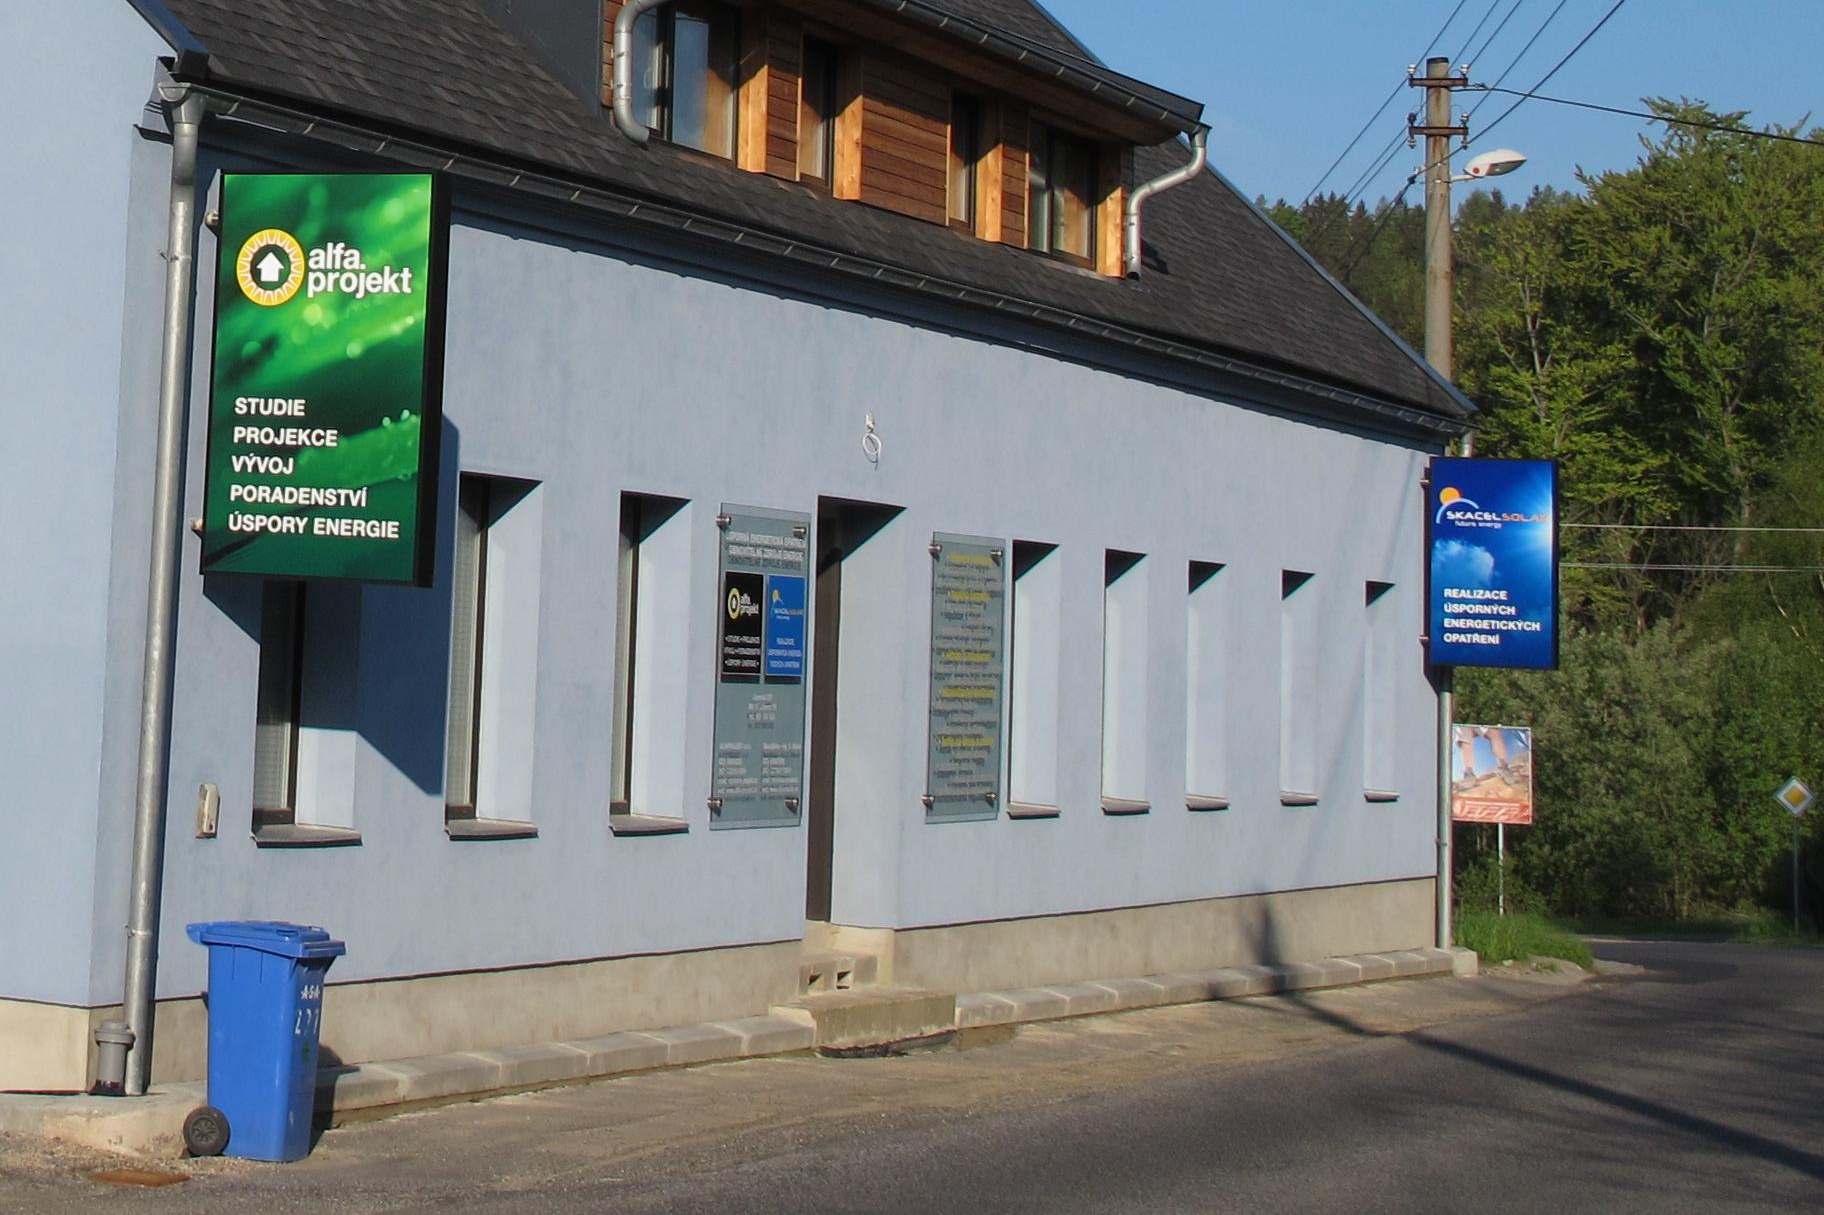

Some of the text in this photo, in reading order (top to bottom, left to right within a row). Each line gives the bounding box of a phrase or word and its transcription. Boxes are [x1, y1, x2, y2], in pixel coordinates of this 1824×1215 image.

[307, 266, 412, 299] projekt
[234, 397, 306, 416] STUDIE
[233, 426, 338, 447] PROJEKCE
[231, 453, 294, 475] VÝVOJ
[230, 484, 368, 507] PORADENSTVÍ
[228, 510, 400, 539] ÚSPORY ENERGIE
[1443, 588, 1508, 600] REALIZACE
[1443, 602, 1516, 616] ÚSPORNÝCH
[1443, 617, 1541, 632] ENERGETICKÝCH
[1443, 632, 1500, 644] OPATŘENÍ
